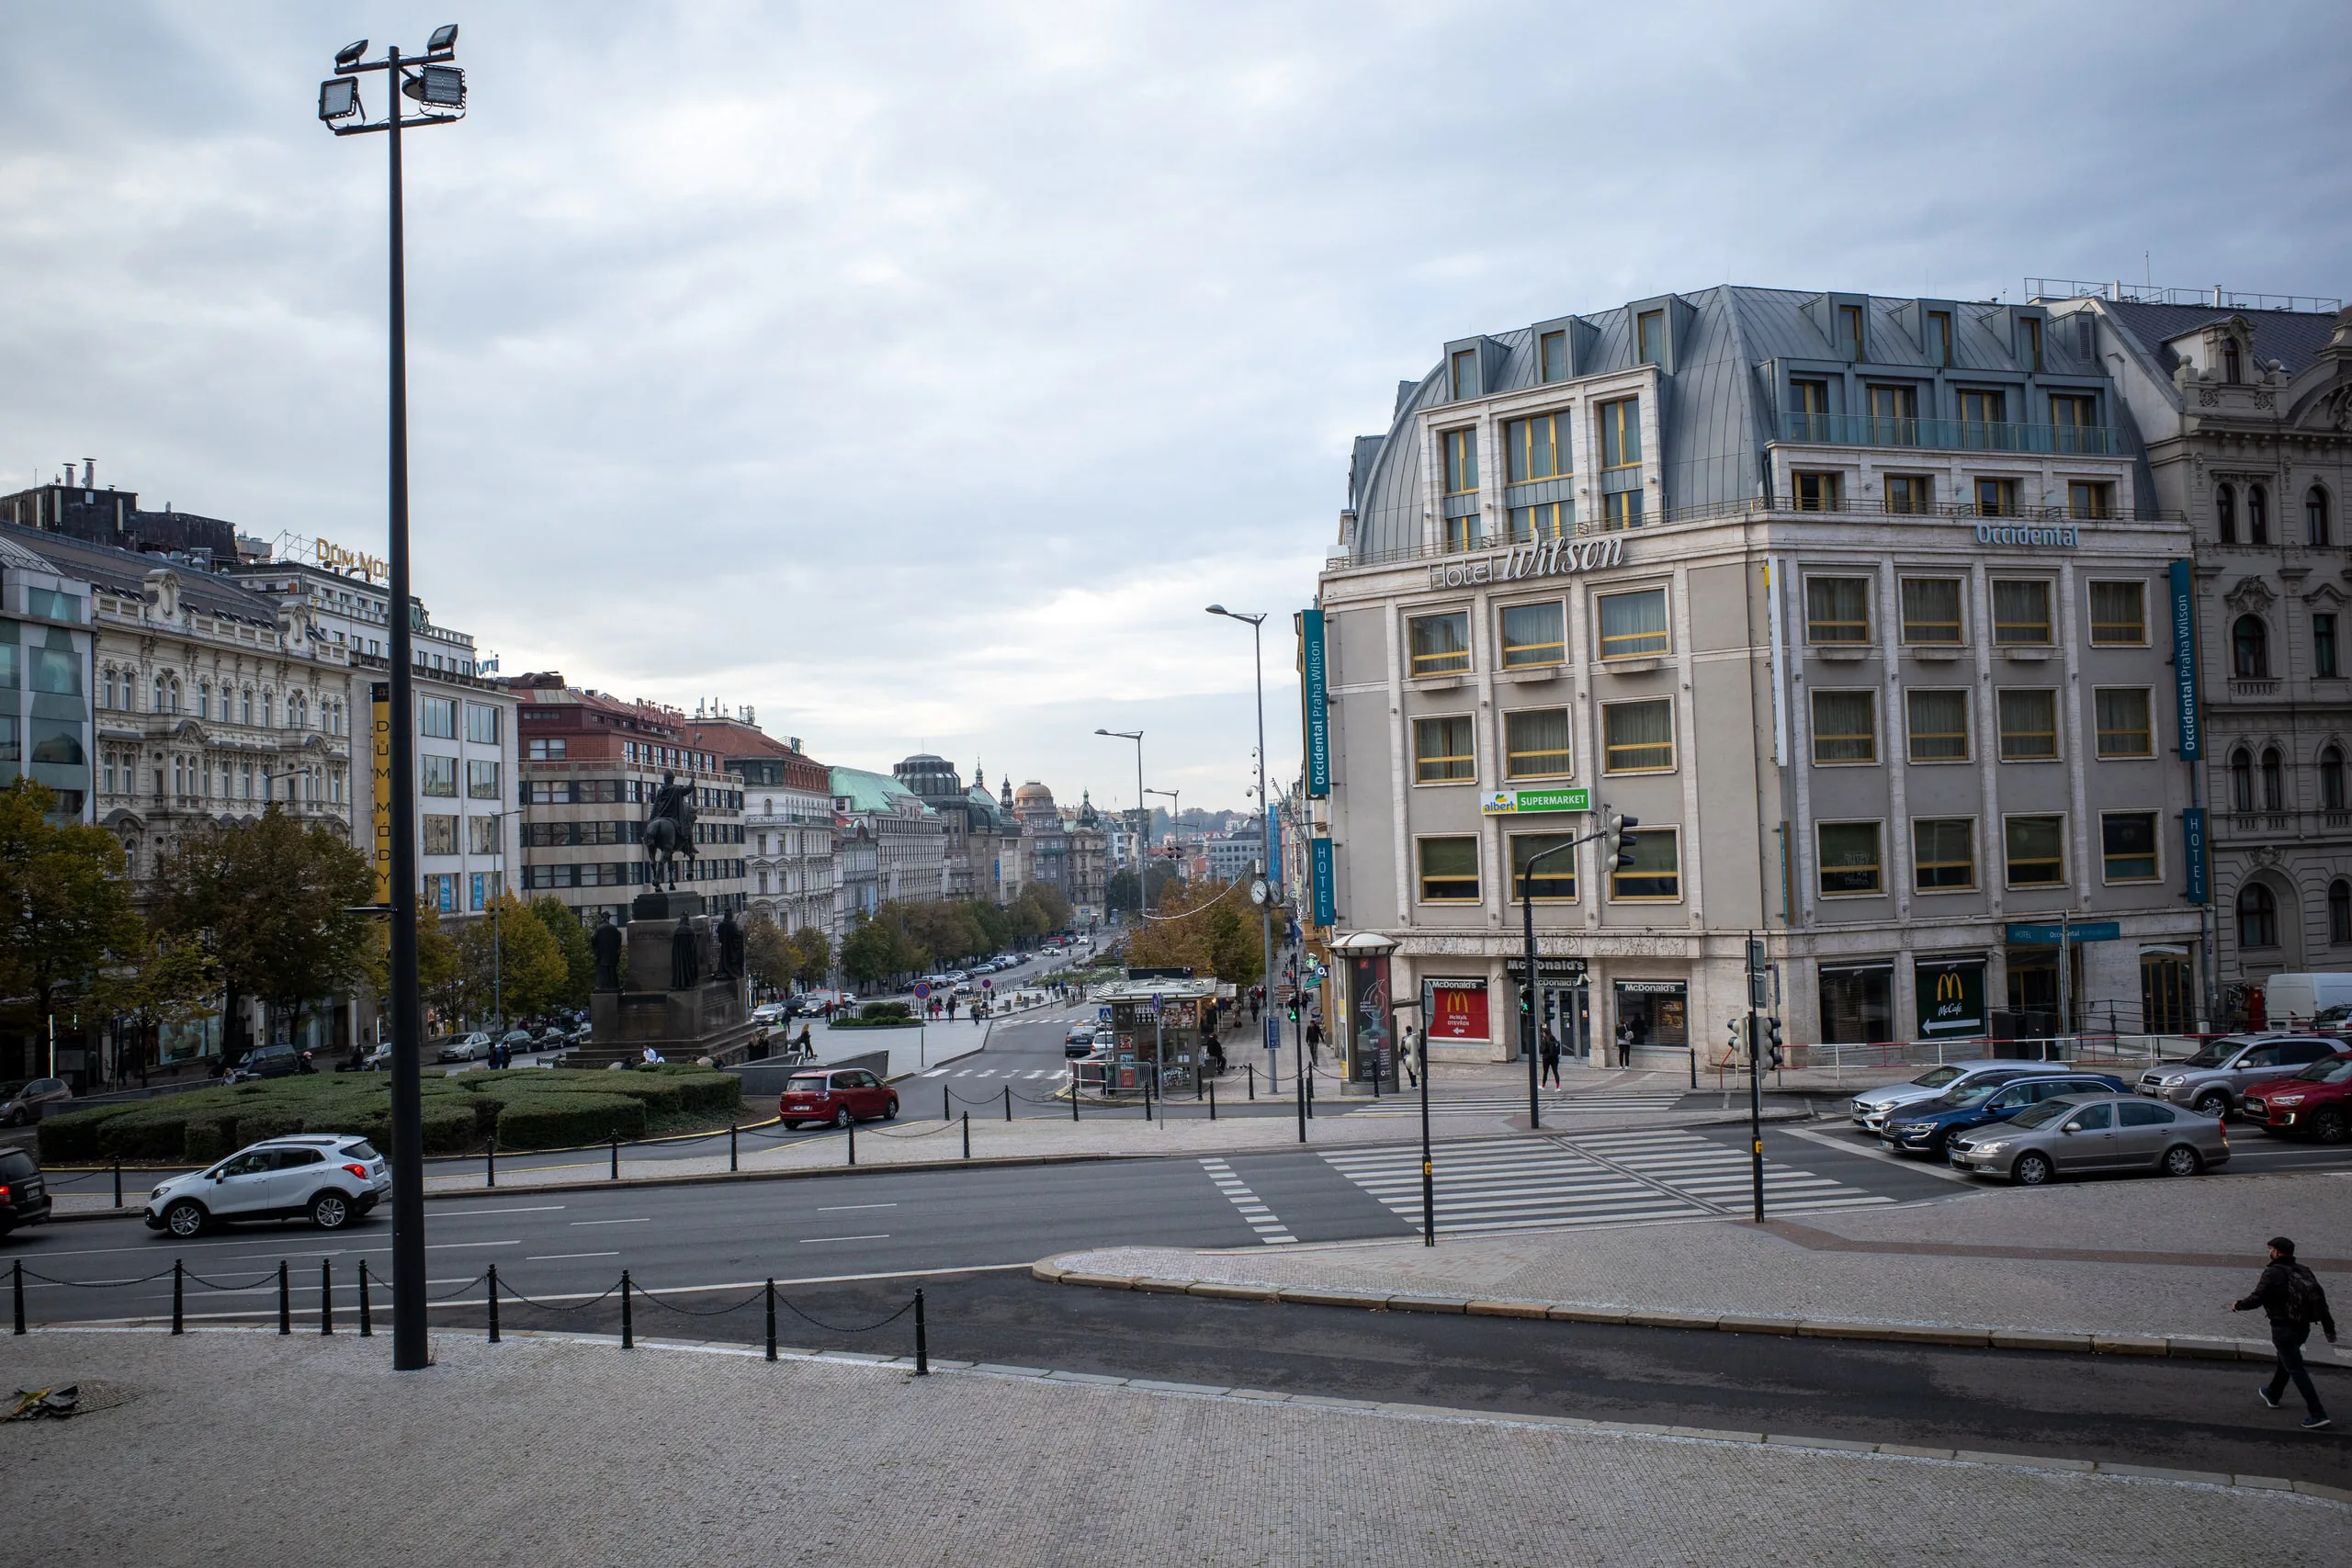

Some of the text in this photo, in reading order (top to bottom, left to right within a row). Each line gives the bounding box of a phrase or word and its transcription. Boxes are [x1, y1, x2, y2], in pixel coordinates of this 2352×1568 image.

[1976, 523, 2078, 547] Occidental
[359, 551, 390, 581] MÓ
[1428, 527, 1624, 590] Hotel Wilson
[2177, 594, 2195, 750] Occidental Praha Wilson
[1309, 641, 1325, 785] Occidental Praha Wilson
[1484, 801, 1515, 812] albert
[1521, 795, 1585, 807] SUPERMARKET
[2190, 818, 2201, 894] HOTEL
[1317, 847, 1327, 918] HOTEL
[1507, 960, 1585, 971] Mconald's
[1432, 981, 1476, 989] McDonald's
[1624, 984, 1676, 992] McDonald's
[1938, 1002, 1962, 1017] McCafé
